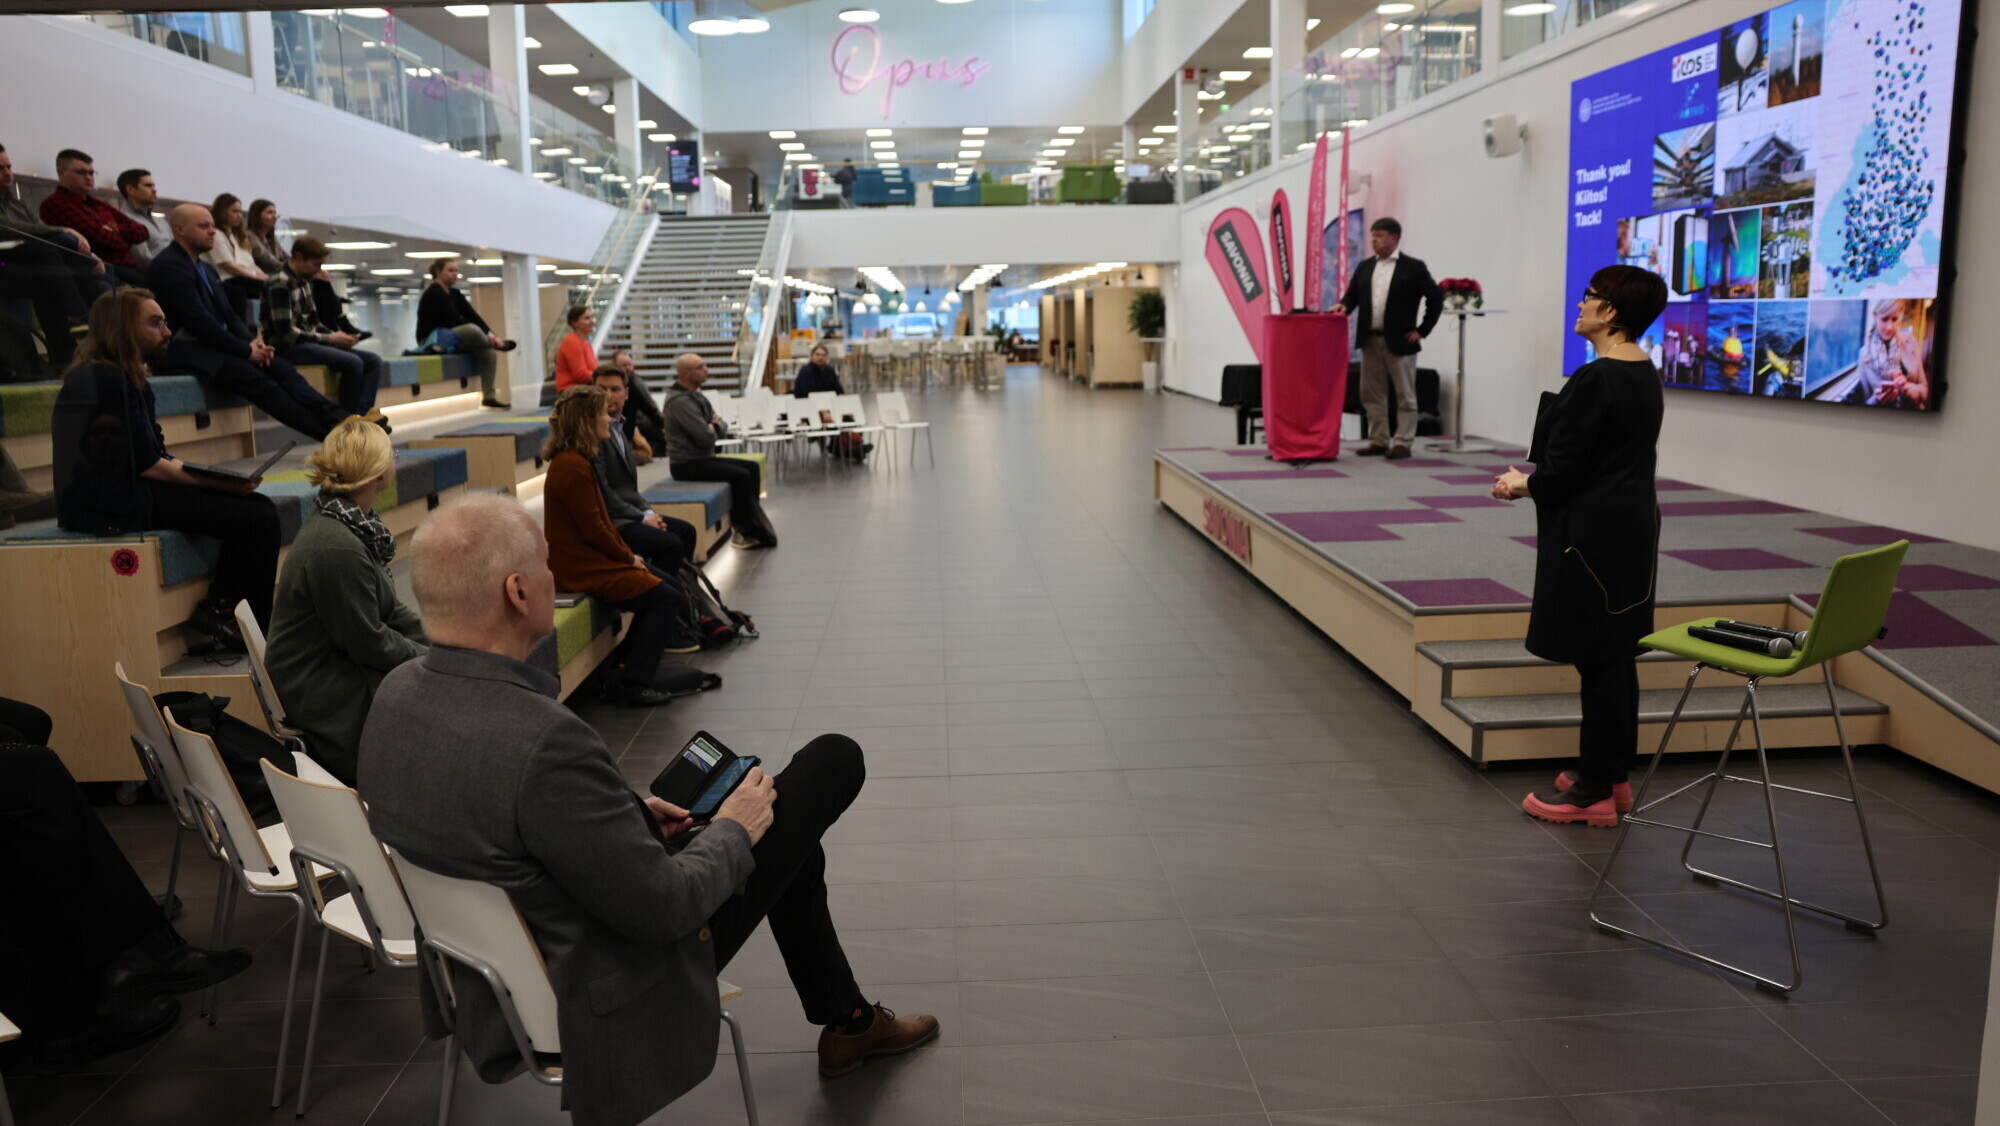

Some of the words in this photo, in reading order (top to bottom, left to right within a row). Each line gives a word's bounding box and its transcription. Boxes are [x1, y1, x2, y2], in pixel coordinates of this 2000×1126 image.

[831, 24, 990, 119] Opus
[1576, 165, 1607, 184] Thank
[1608, 158, 1631, 182] you!
[1575, 186, 1607, 206] Kiitos!
[1574, 209, 1602, 227] Tack!
[1220, 231, 1255, 294] SAVONIA
